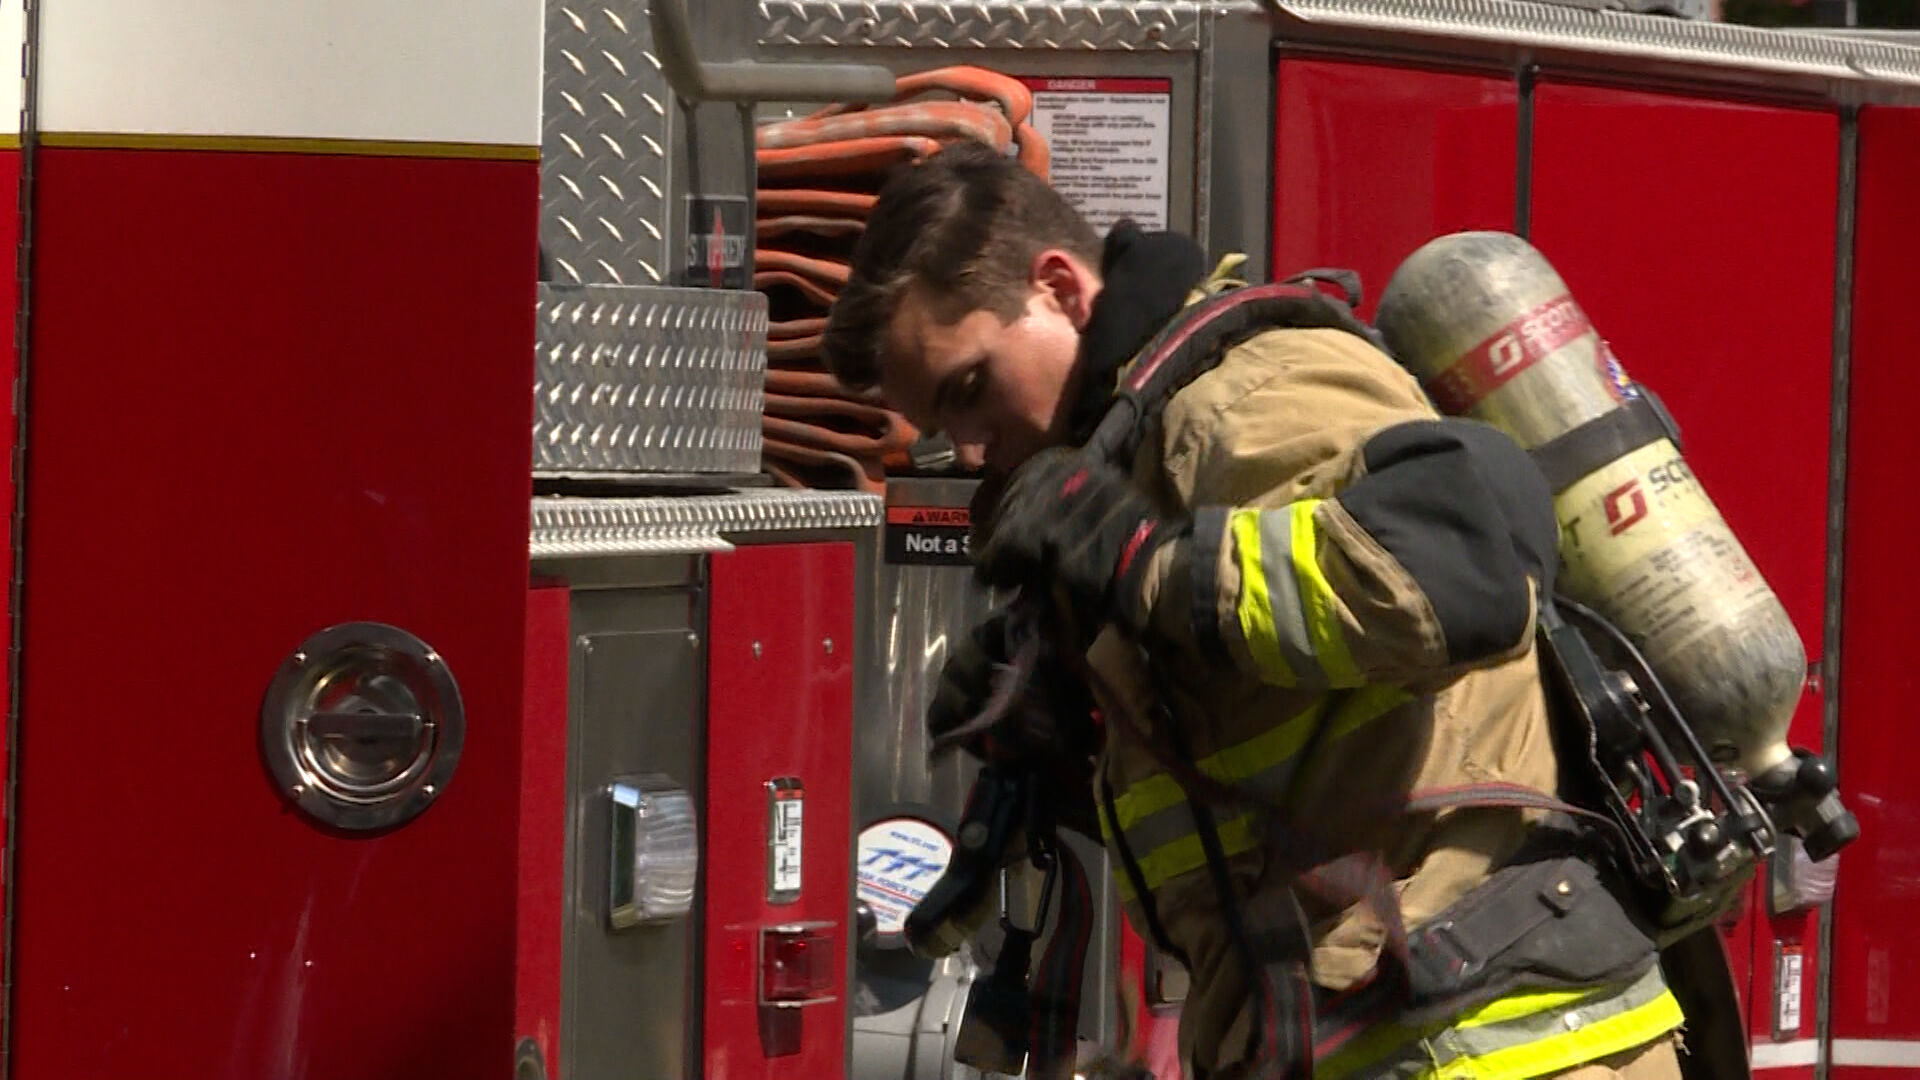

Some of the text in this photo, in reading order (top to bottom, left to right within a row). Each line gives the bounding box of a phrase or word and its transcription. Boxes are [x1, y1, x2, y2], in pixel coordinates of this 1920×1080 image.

[1047, 80, 1096, 89] DANGER
[926, 511, 969, 521] WARN
[905, 533, 942, 554] Not
[944, 538, 957, 553] a
